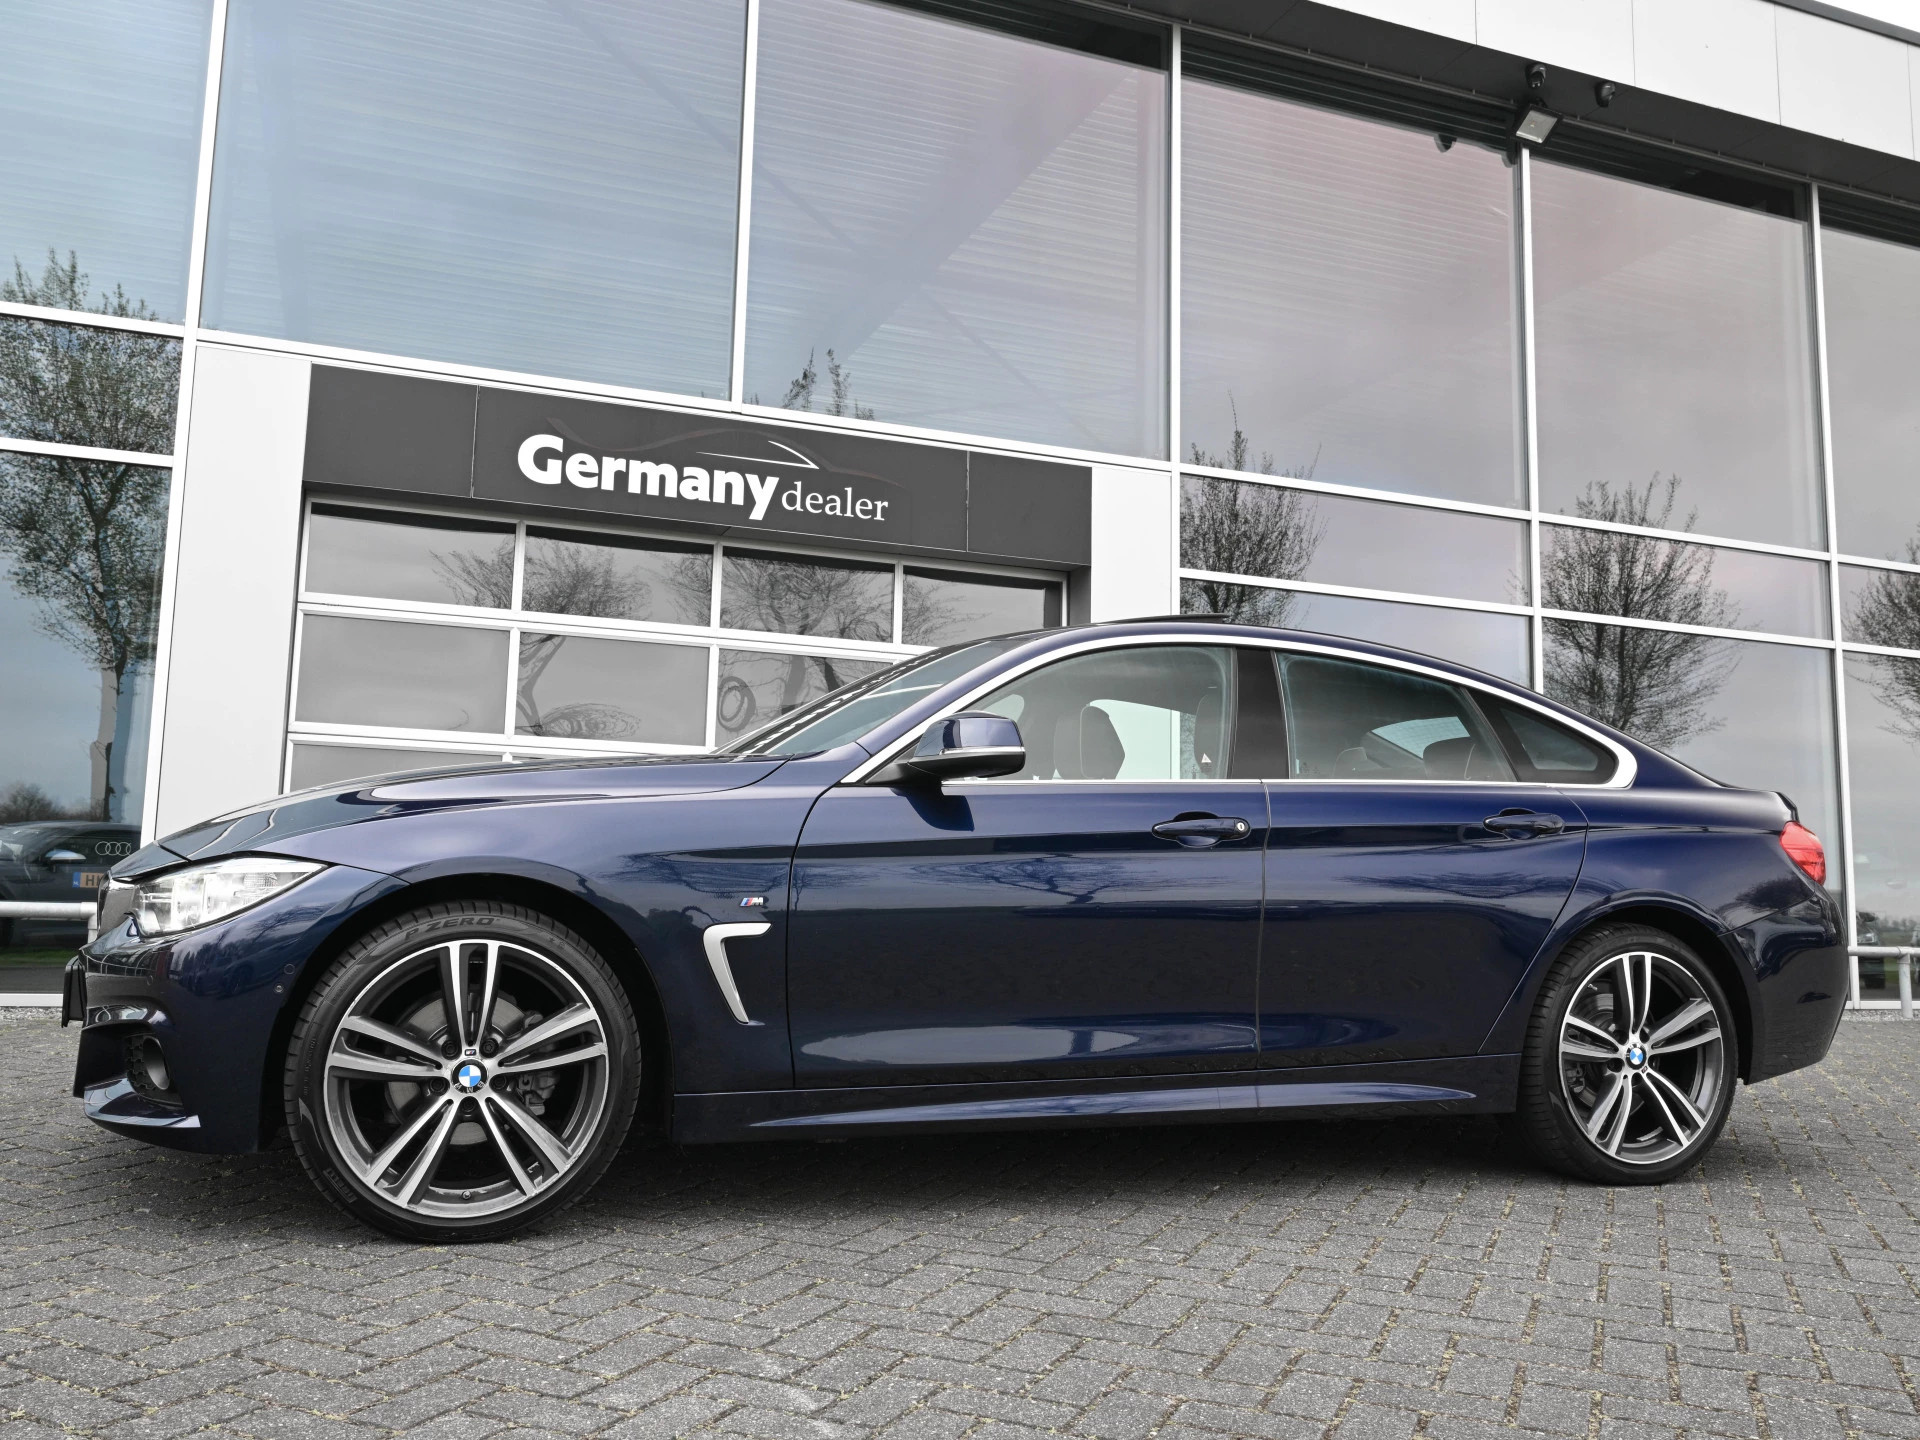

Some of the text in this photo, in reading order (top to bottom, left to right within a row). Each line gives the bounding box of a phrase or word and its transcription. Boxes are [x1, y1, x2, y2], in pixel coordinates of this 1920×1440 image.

[517, 433, 888, 521] Germany dealer
[405, 917, 495, 941] P ZERO
